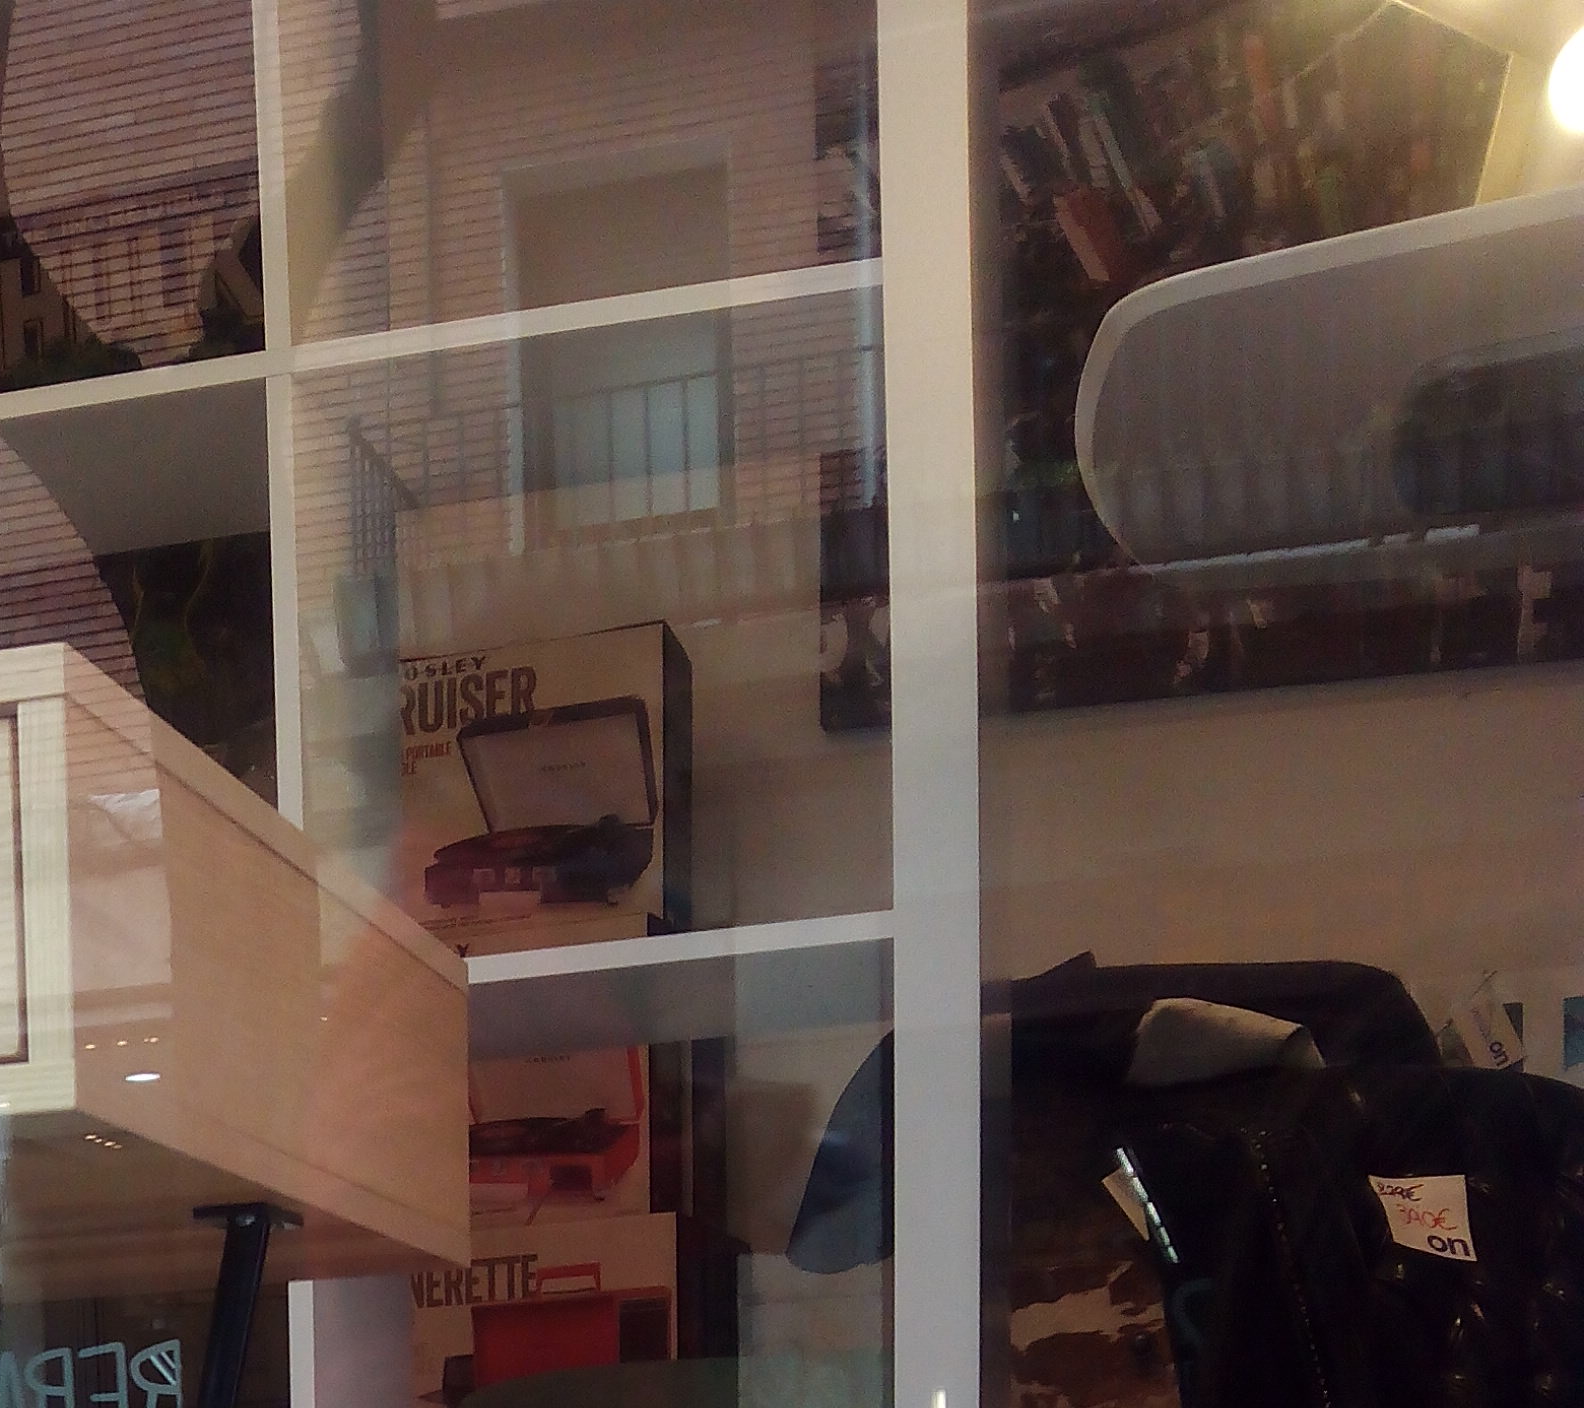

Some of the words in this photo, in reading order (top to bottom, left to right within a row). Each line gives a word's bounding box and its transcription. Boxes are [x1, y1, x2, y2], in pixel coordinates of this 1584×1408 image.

[404, 655, 487, 681] OSLEY
[400, 665, 537, 736] RUISER
[1427, 1235, 1471, 1257] on
